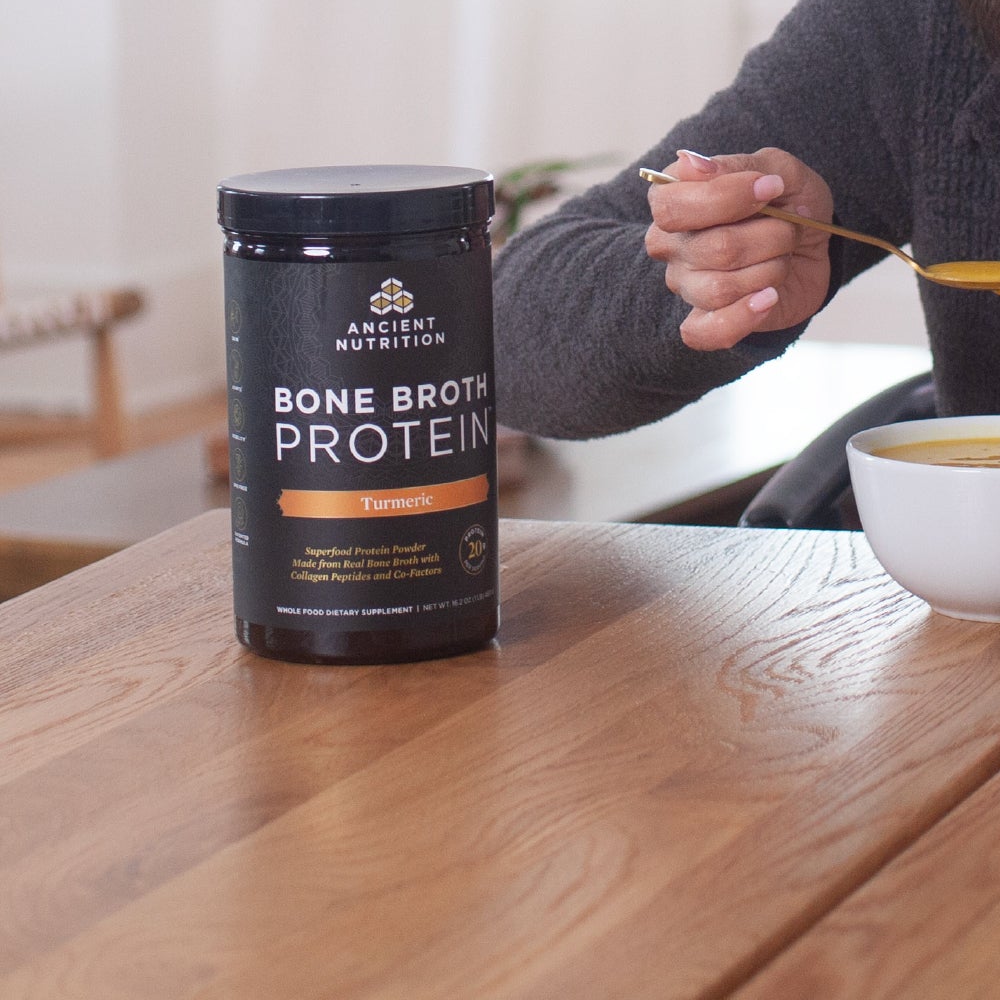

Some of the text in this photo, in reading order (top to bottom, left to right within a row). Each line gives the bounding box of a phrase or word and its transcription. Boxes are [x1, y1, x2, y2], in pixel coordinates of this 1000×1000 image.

[347, 317, 436, 334] ANCIENT
[335, 332, 445, 351] NUTRITION
[274, 372, 488, 415] BONE BROTH
[275, 407, 489, 463] PROTEIN
[360, 493, 433, 511] Turmeric
[305, 543, 426, 558] Superfood Protein Powder
[292, 553, 440, 570] Made from Real Bone Broth with
[290, 567, 442, 583] Collagen Peptides and Co-Factors
[276, 606, 301, 615] WHOLE
[302, 608, 324, 616] FOOD
[361, 606, 413, 615] SUPPLEMENT
